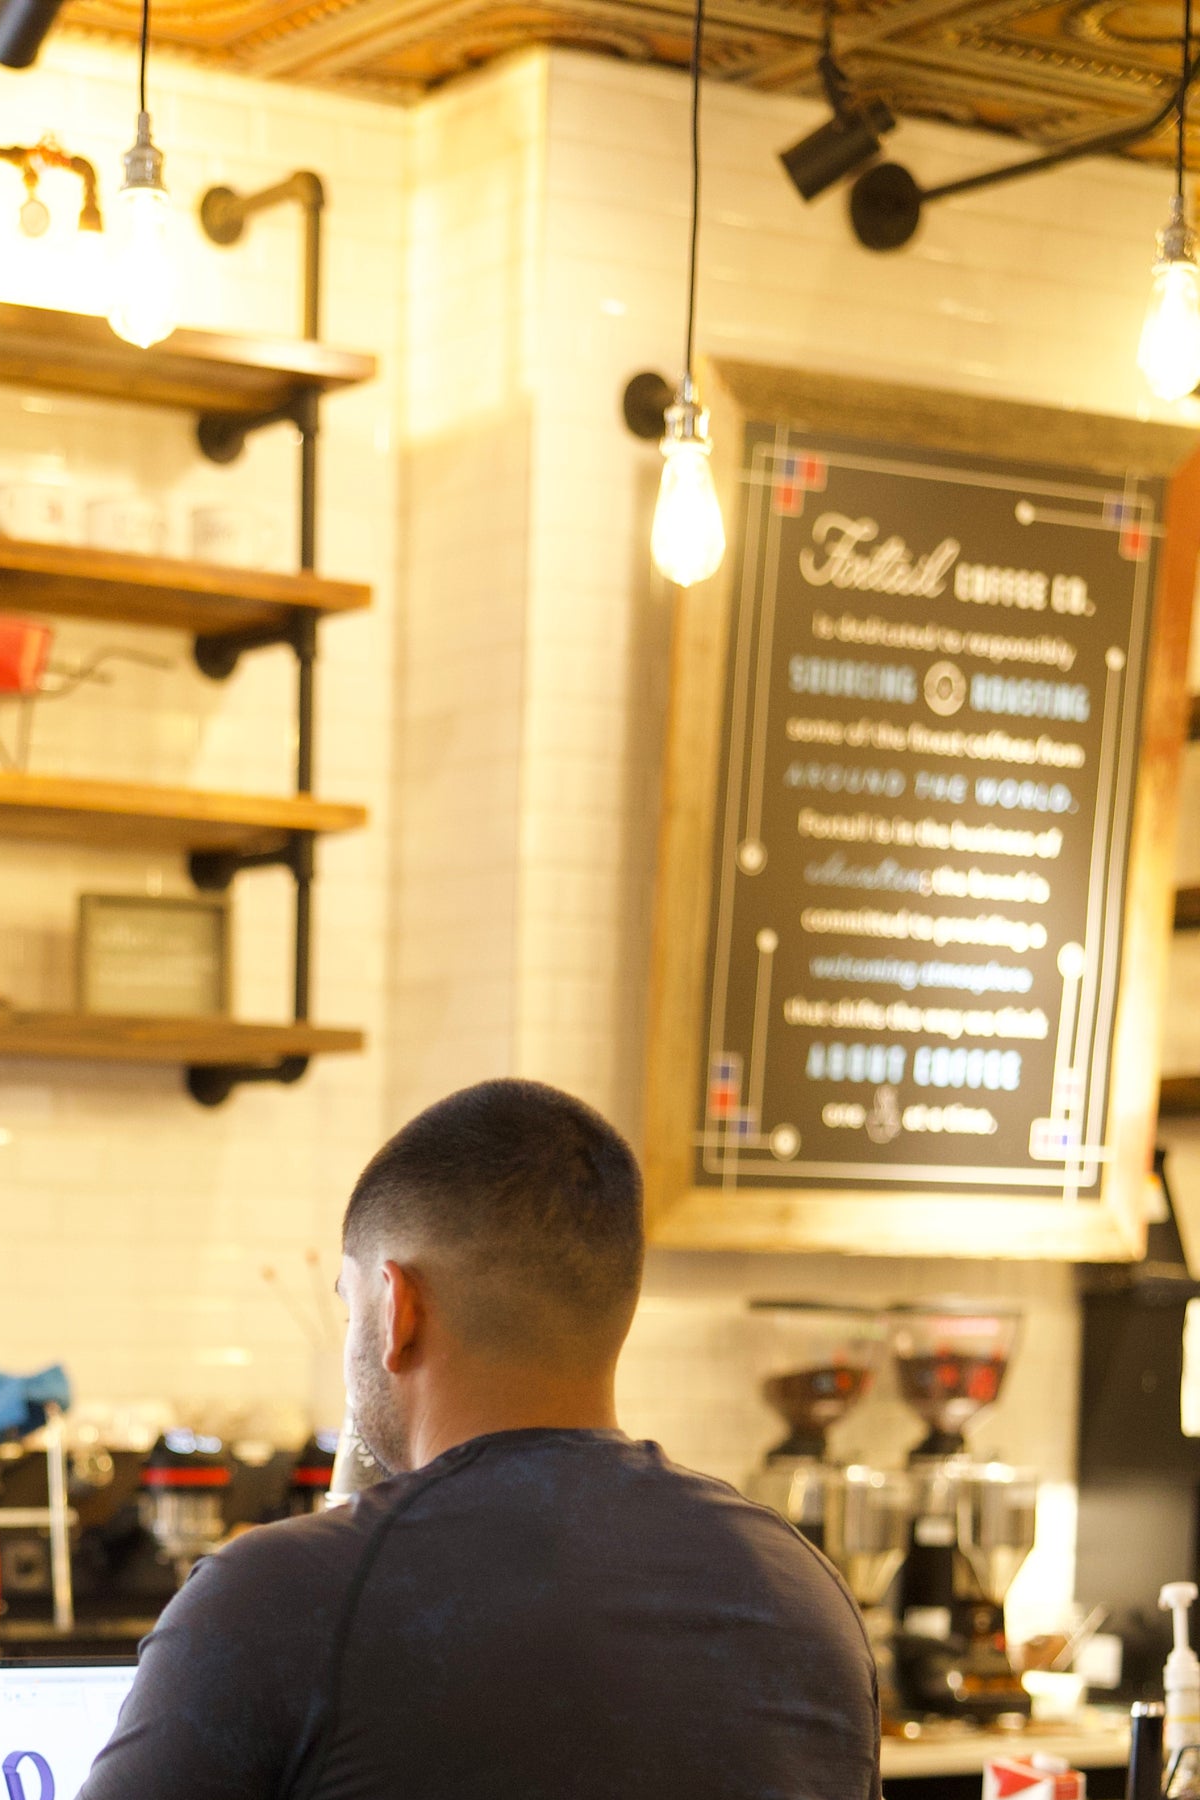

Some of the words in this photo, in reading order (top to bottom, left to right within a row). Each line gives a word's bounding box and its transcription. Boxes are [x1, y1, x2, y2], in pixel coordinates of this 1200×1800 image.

[954, 561, 1049, 611] COFFEE
[784, 761, 906, 799] AROUND
[806, 1041, 907, 1083] ABOUT
[913, 1046, 1022, 1091] COFFEE
